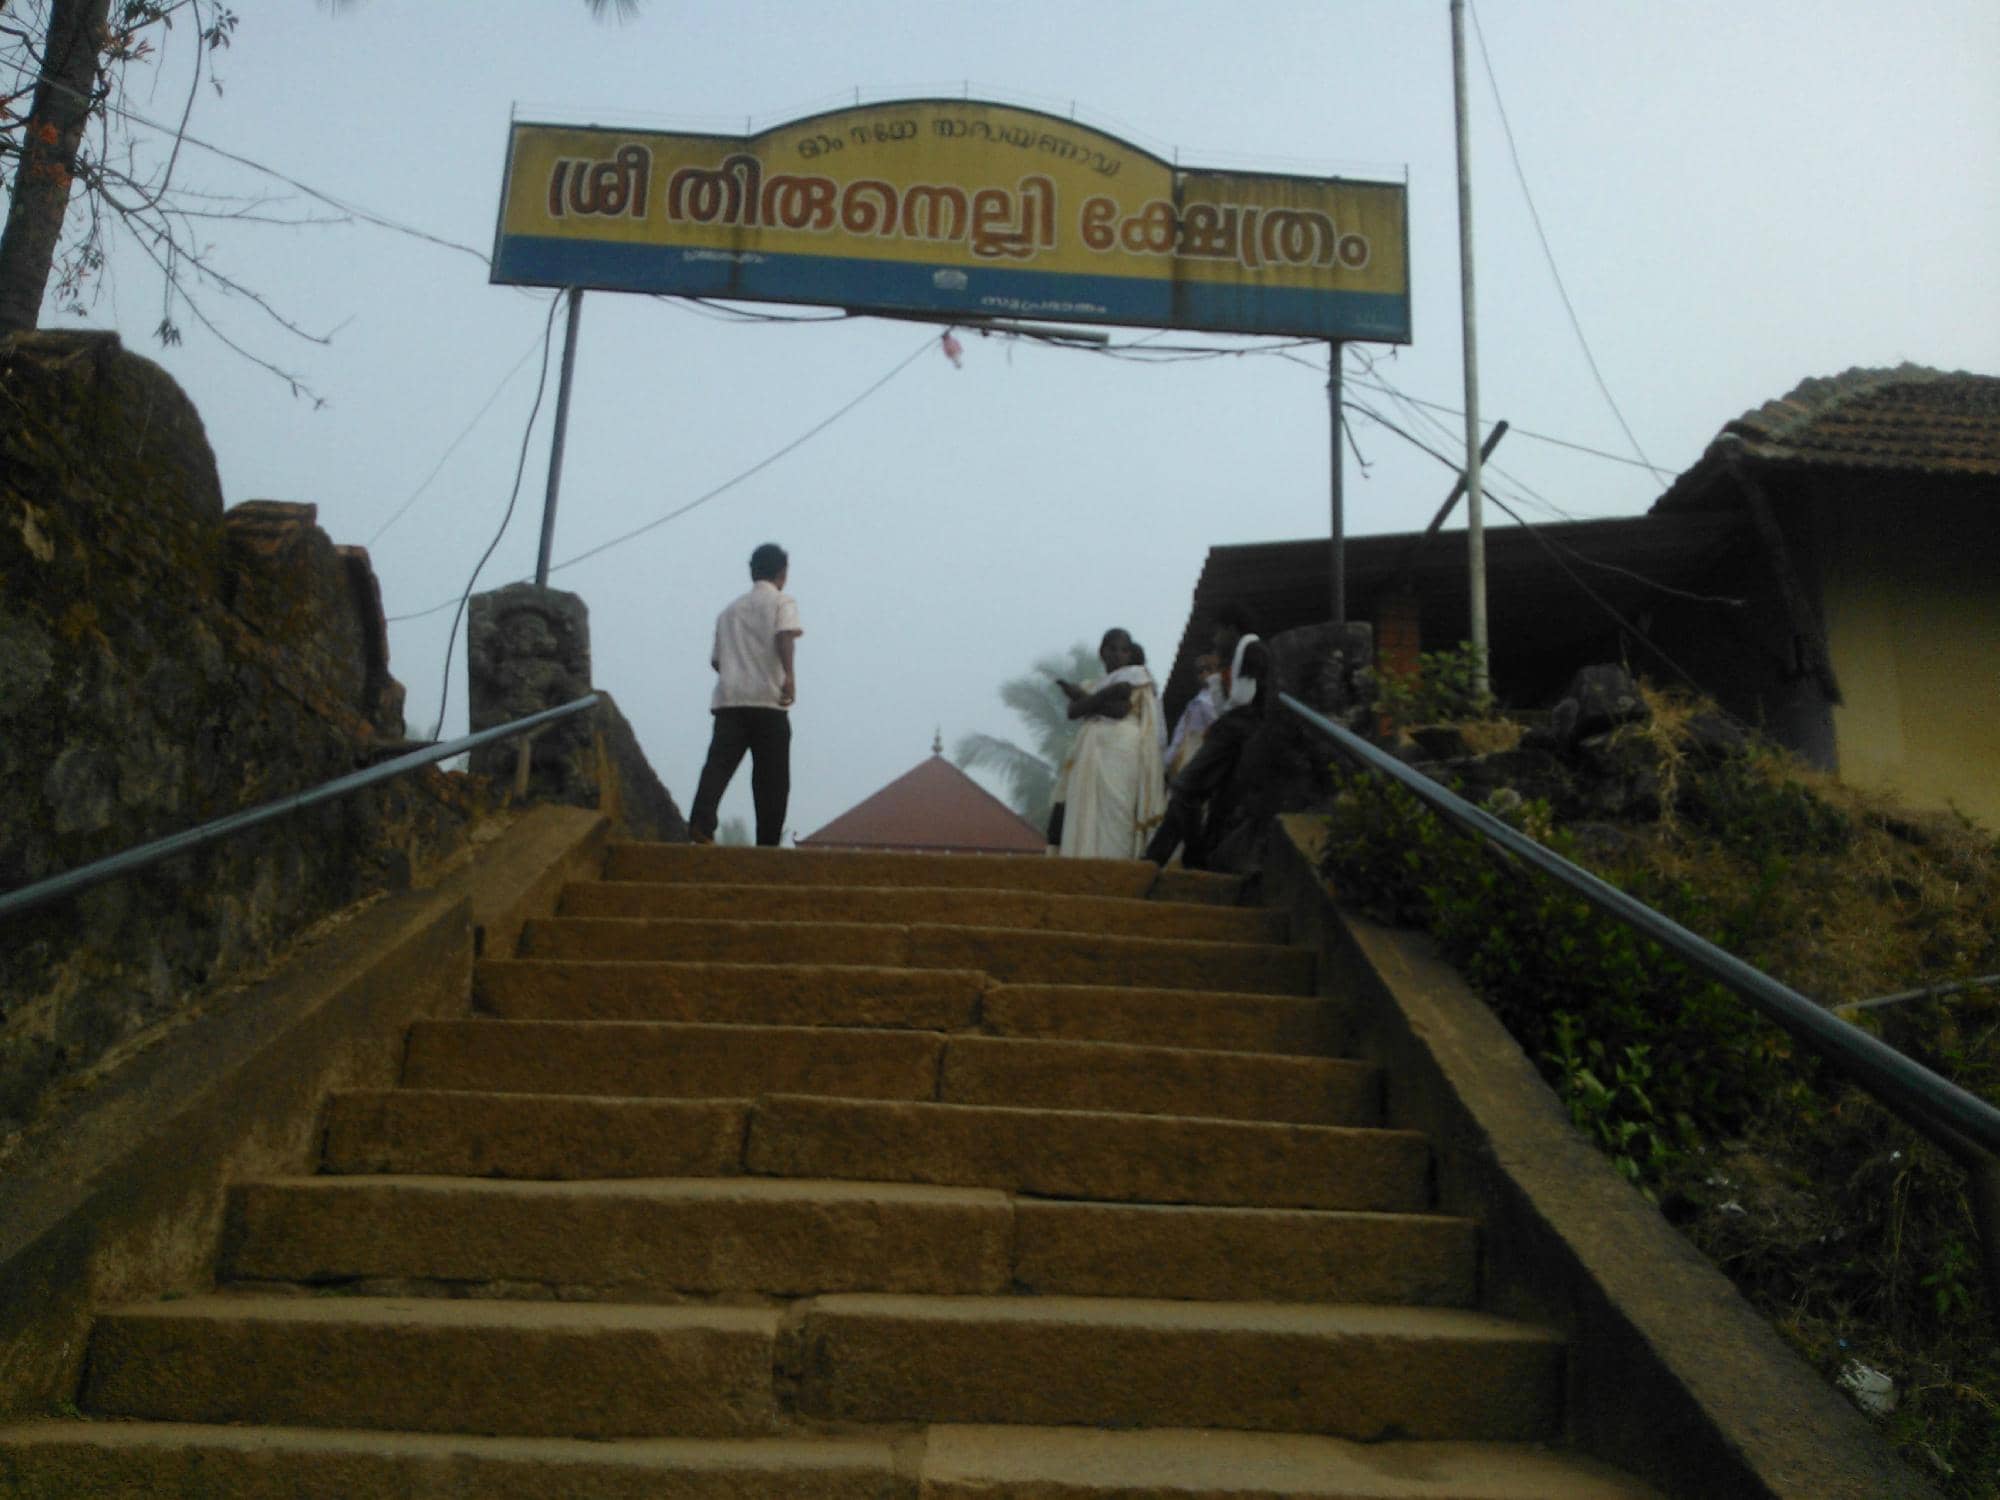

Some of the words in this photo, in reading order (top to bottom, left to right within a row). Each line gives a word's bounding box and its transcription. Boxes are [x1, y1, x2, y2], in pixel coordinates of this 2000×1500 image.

[548, 144, 652, 219] ശ്രീ
[667, 153, 1057, 259] തിരുനെല്ലി
[1080, 197, 1369, 269] ക്ഷേത്രം
